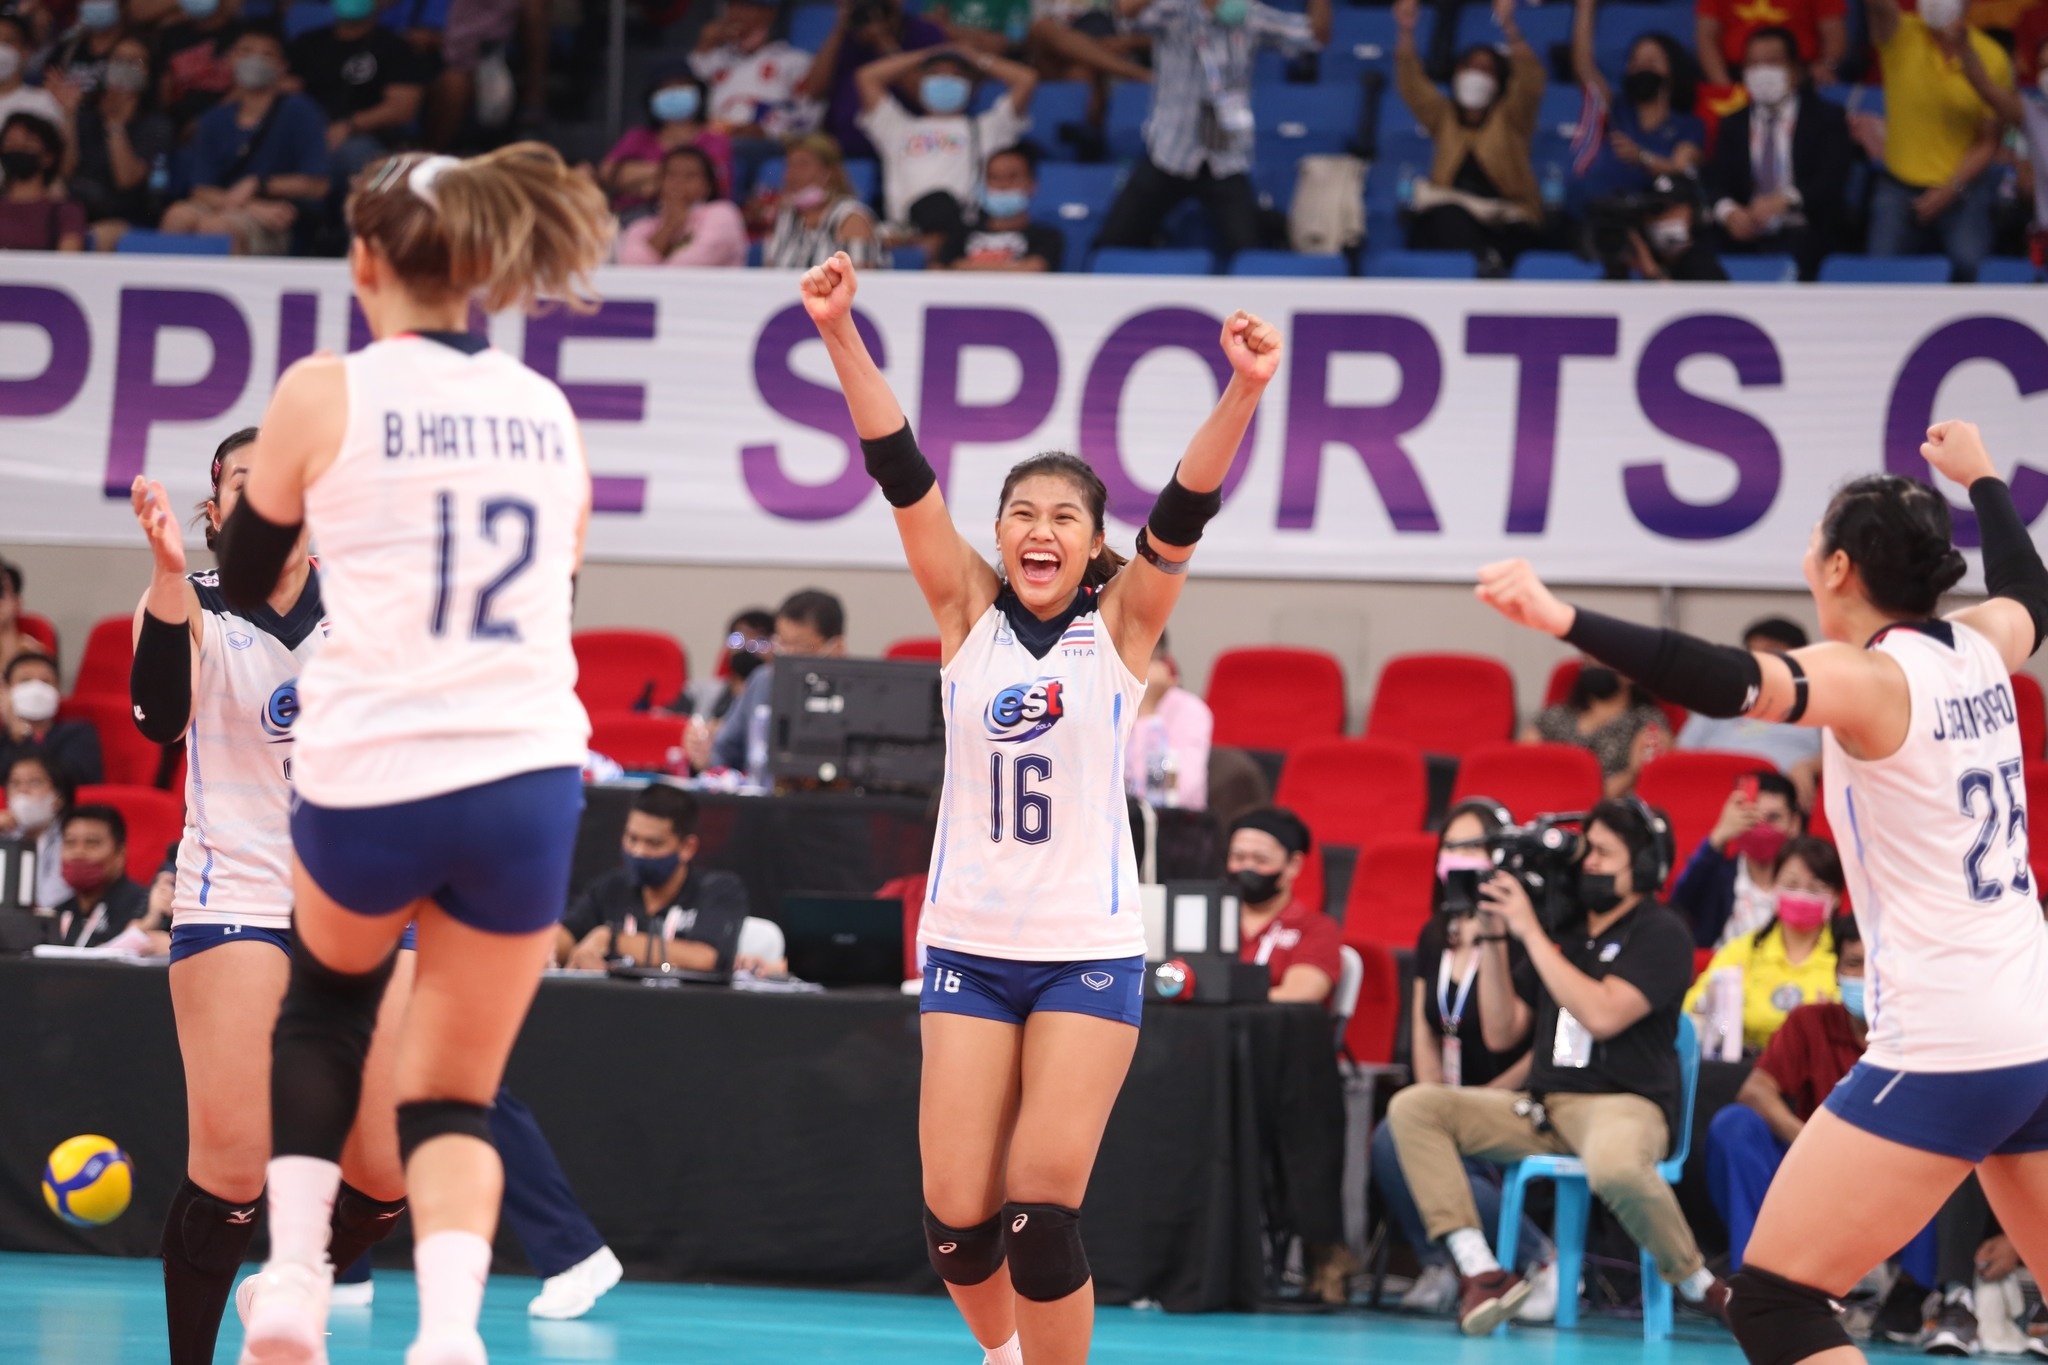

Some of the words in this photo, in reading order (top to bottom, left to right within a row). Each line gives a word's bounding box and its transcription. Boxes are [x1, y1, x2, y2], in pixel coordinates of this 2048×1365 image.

[739, 303, 1784, 541] SPORTS
[429, 488, 538, 643] 12
[1062, 648, 1096, 657] THA
[992, 680, 1064, 728] est
[1035, 722, 1053, 731] COLA
[990, 751, 1053, 845] 16
[1957, 757, 2030, 903] 25
[933, 967, 963, 993] 16
